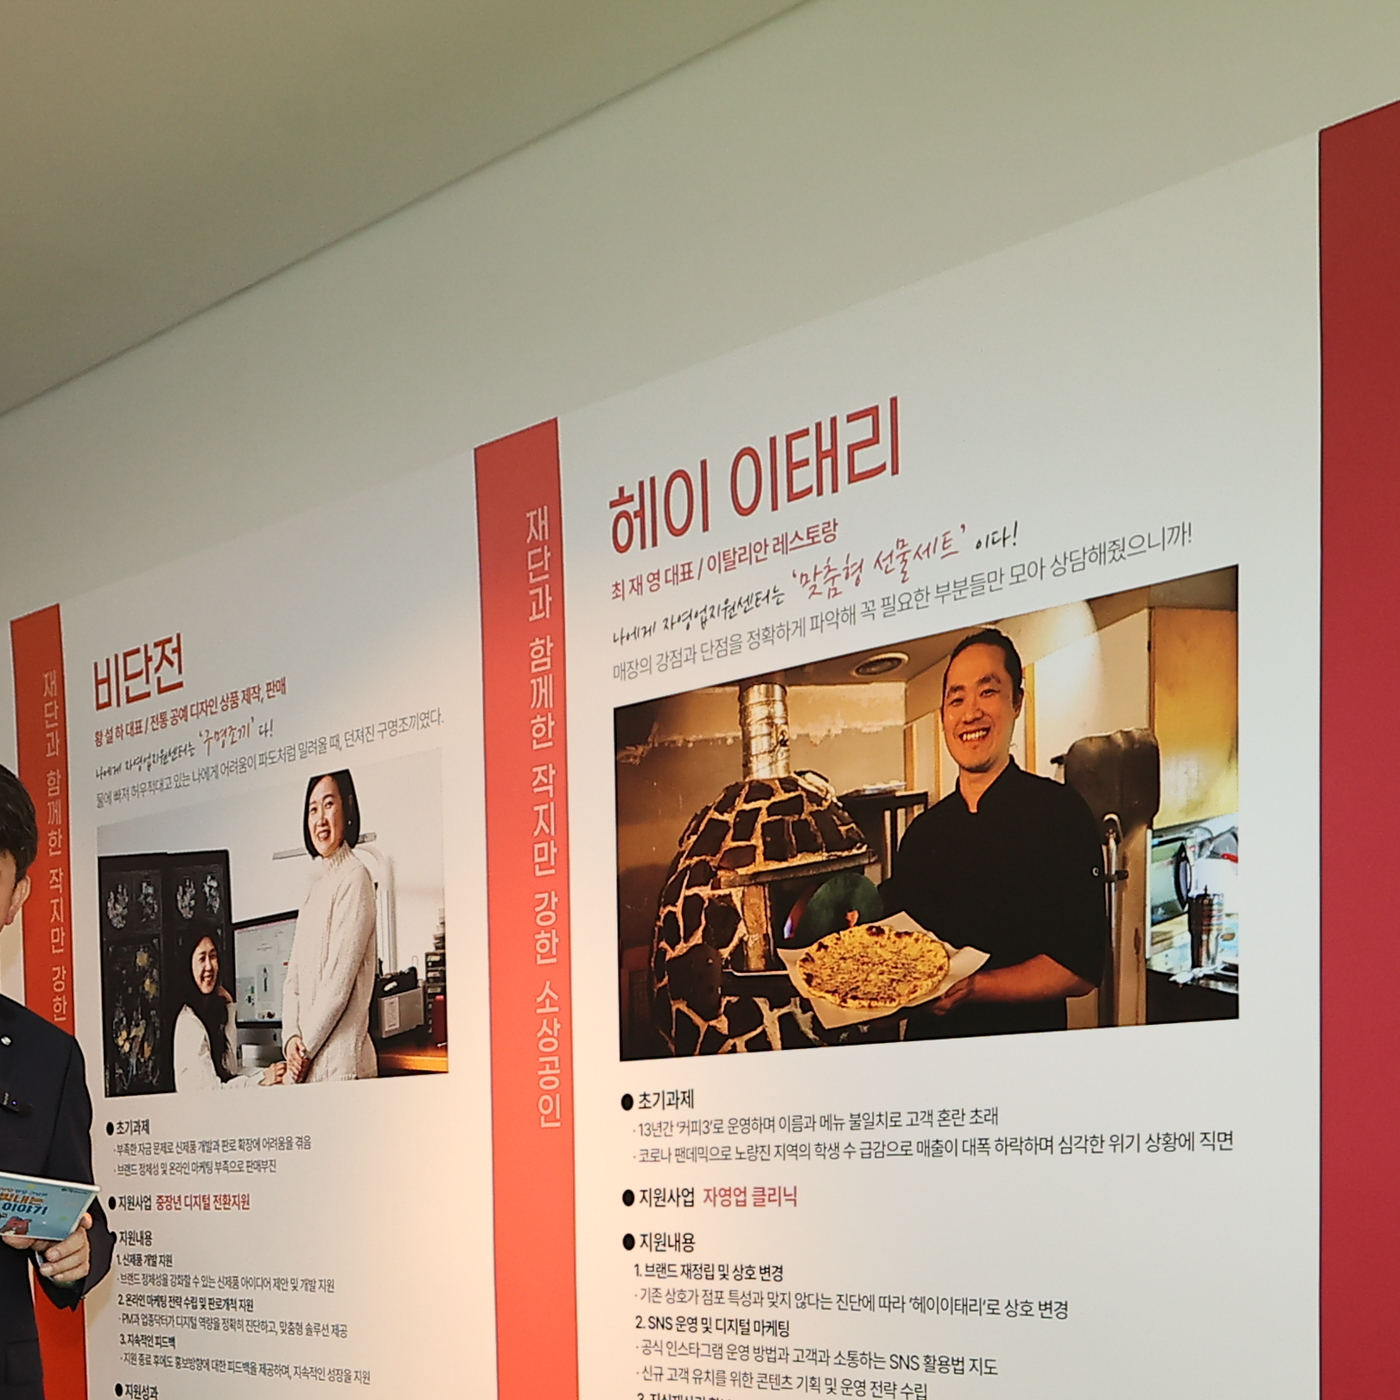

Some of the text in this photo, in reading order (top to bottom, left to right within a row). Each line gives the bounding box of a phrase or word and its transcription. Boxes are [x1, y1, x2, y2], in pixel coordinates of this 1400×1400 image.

[609, 396, 901, 554] 헤이 이태리
[665, 518, 838, 586] 대표 이탈리안 레스토랑
[613, 622, 657, 647] 나에게
[661, 585, 785, 633] 자영업지원센터는
[974, 520, 1020, 551] 이다!
[93, 632, 184, 712] 비단전
[526, 505, 562, 1128] 재단과 함께한 작지만 강한 소상공인
[43, 669, 67, 1023] 재단과 함께한 작지만 강한
[639, 1089, 694, 1110] 초기과제
[117, 1119, 149, 1135] 초기과제
[639, 1121, 673, 1137] 13년간
[728, 1116, 775, 1135] 운영하며
[779, 1114, 816, 1133] 이름과
[820, 1114, 845, 1131] 메뉴
[849, 1111, 902, 1130] 불일치로
[906, 1110, 933, 1128] 고객
[937, 1108, 966, 1127] 혼란
[969, 1107, 998, 1125] 초래
[118, 1194, 250, 1211] 지원사업 중장년 디지털 전환지원
[640, 1186, 796, 1207] 지원사업 자영업 클리닉
[119, 1230, 152, 1246] 지원내용
[640, 1232, 695, 1253] 지원내용
[123, 1254, 142, 1267] 신제품
[144, 1254, 157, 1267] 개발
[159, 1254, 172, 1267] 지원
[634, 1263, 783, 1282] 1. 브랜드 재정립 및 상호 변경
[125, 1384, 158, 1400] 지원성과
